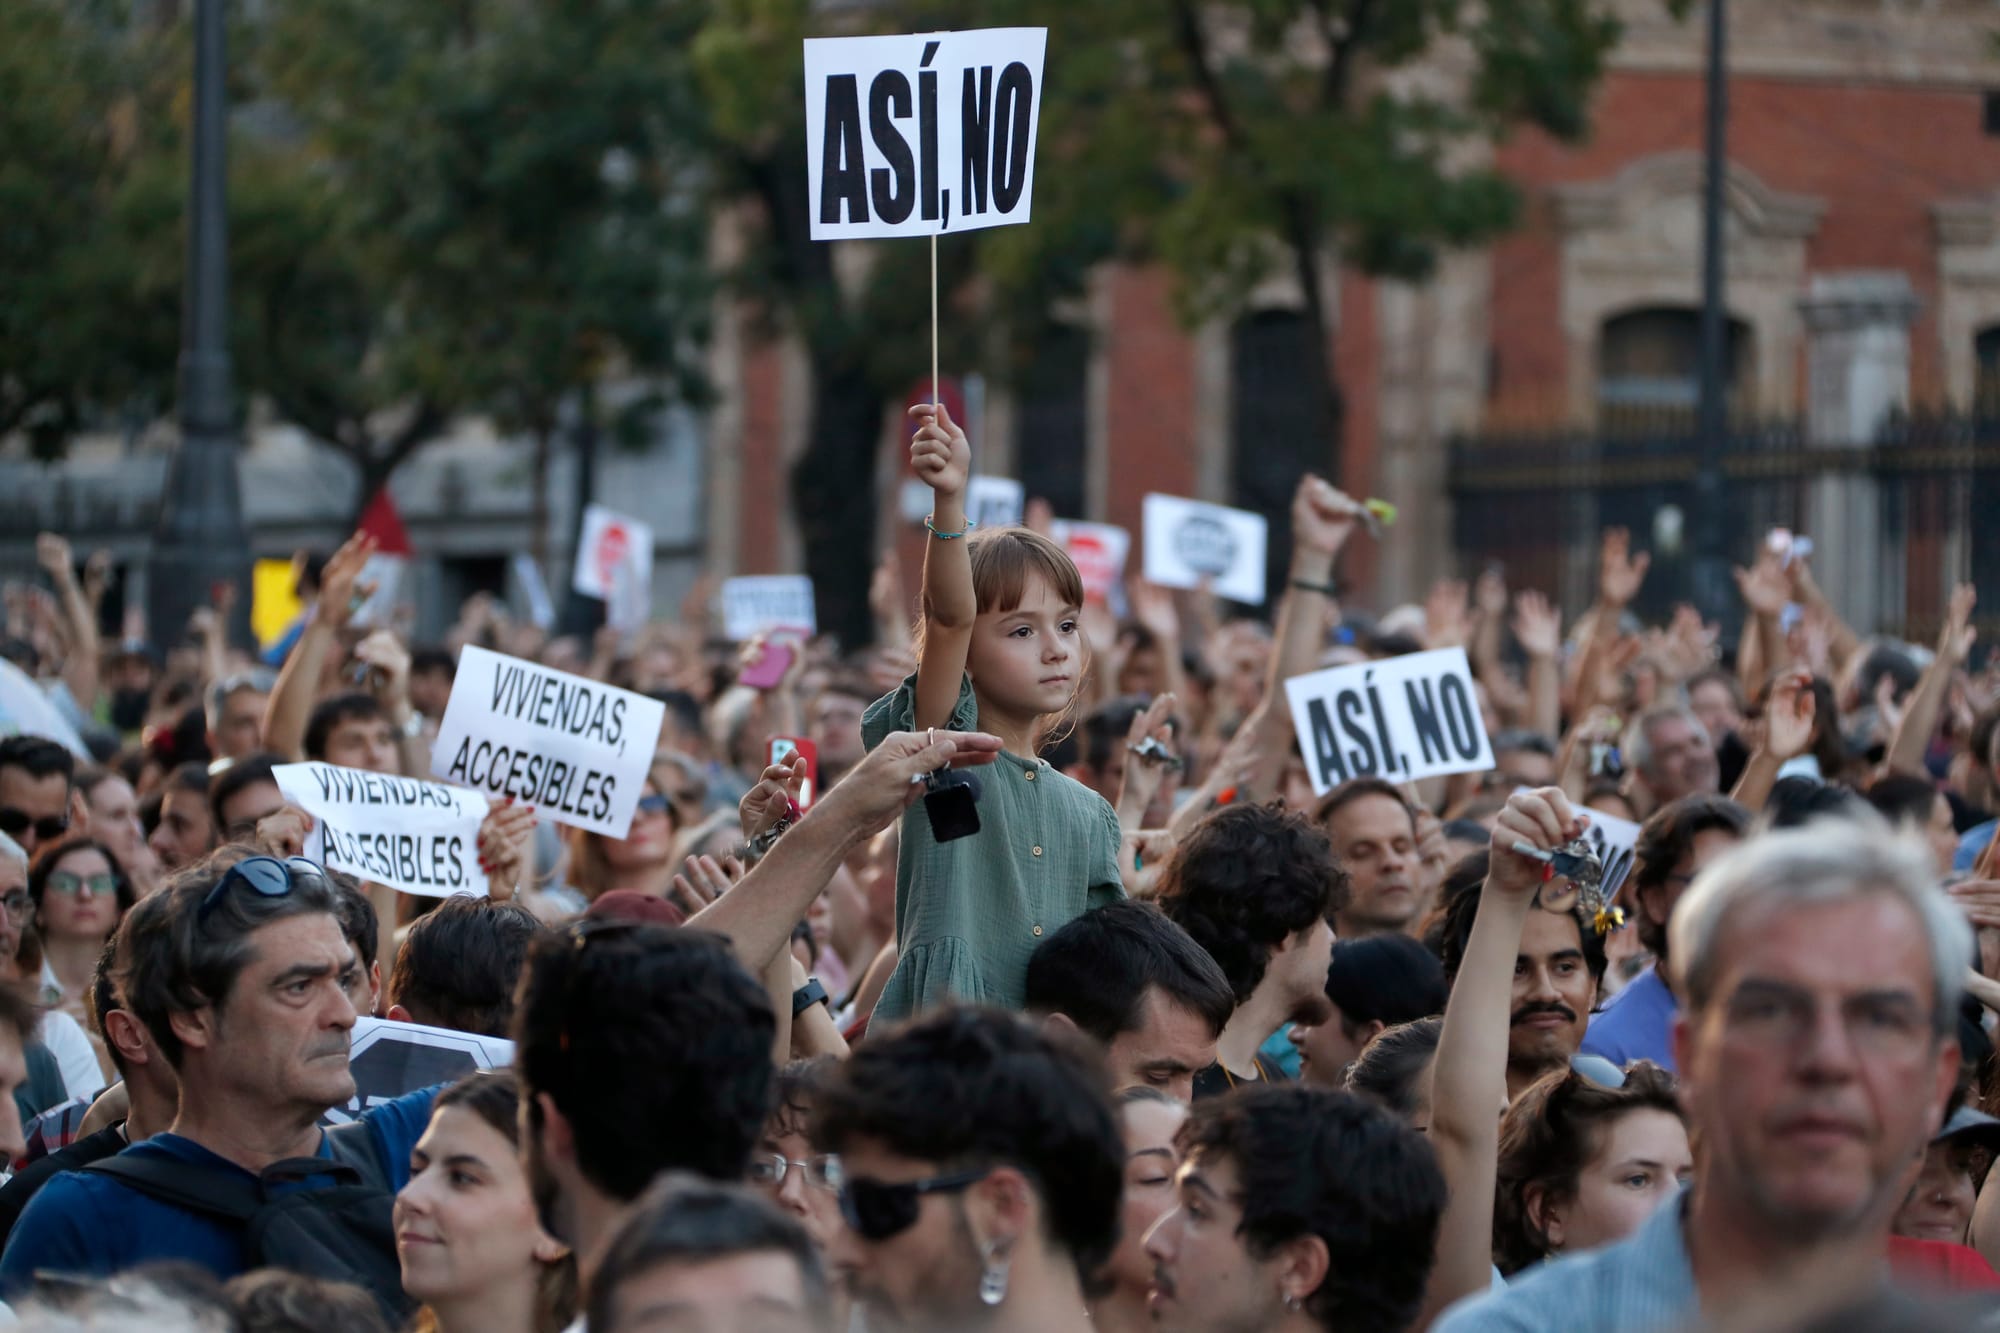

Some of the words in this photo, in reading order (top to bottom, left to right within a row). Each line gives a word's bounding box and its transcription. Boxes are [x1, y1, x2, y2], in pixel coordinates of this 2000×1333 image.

[820, 41, 950, 230] ASÍ,
[962, 61, 1033, 217] NO
[491, 662, 627, 758] VIVIENDAS,
[1307, 669, 1411, 786] ASÍ,
[1404, 672, 1481, 765] NO
[449, 735, 617, 825] ACCESIBLES.
[321, 818, 470, 888] ACCESIBLES.
